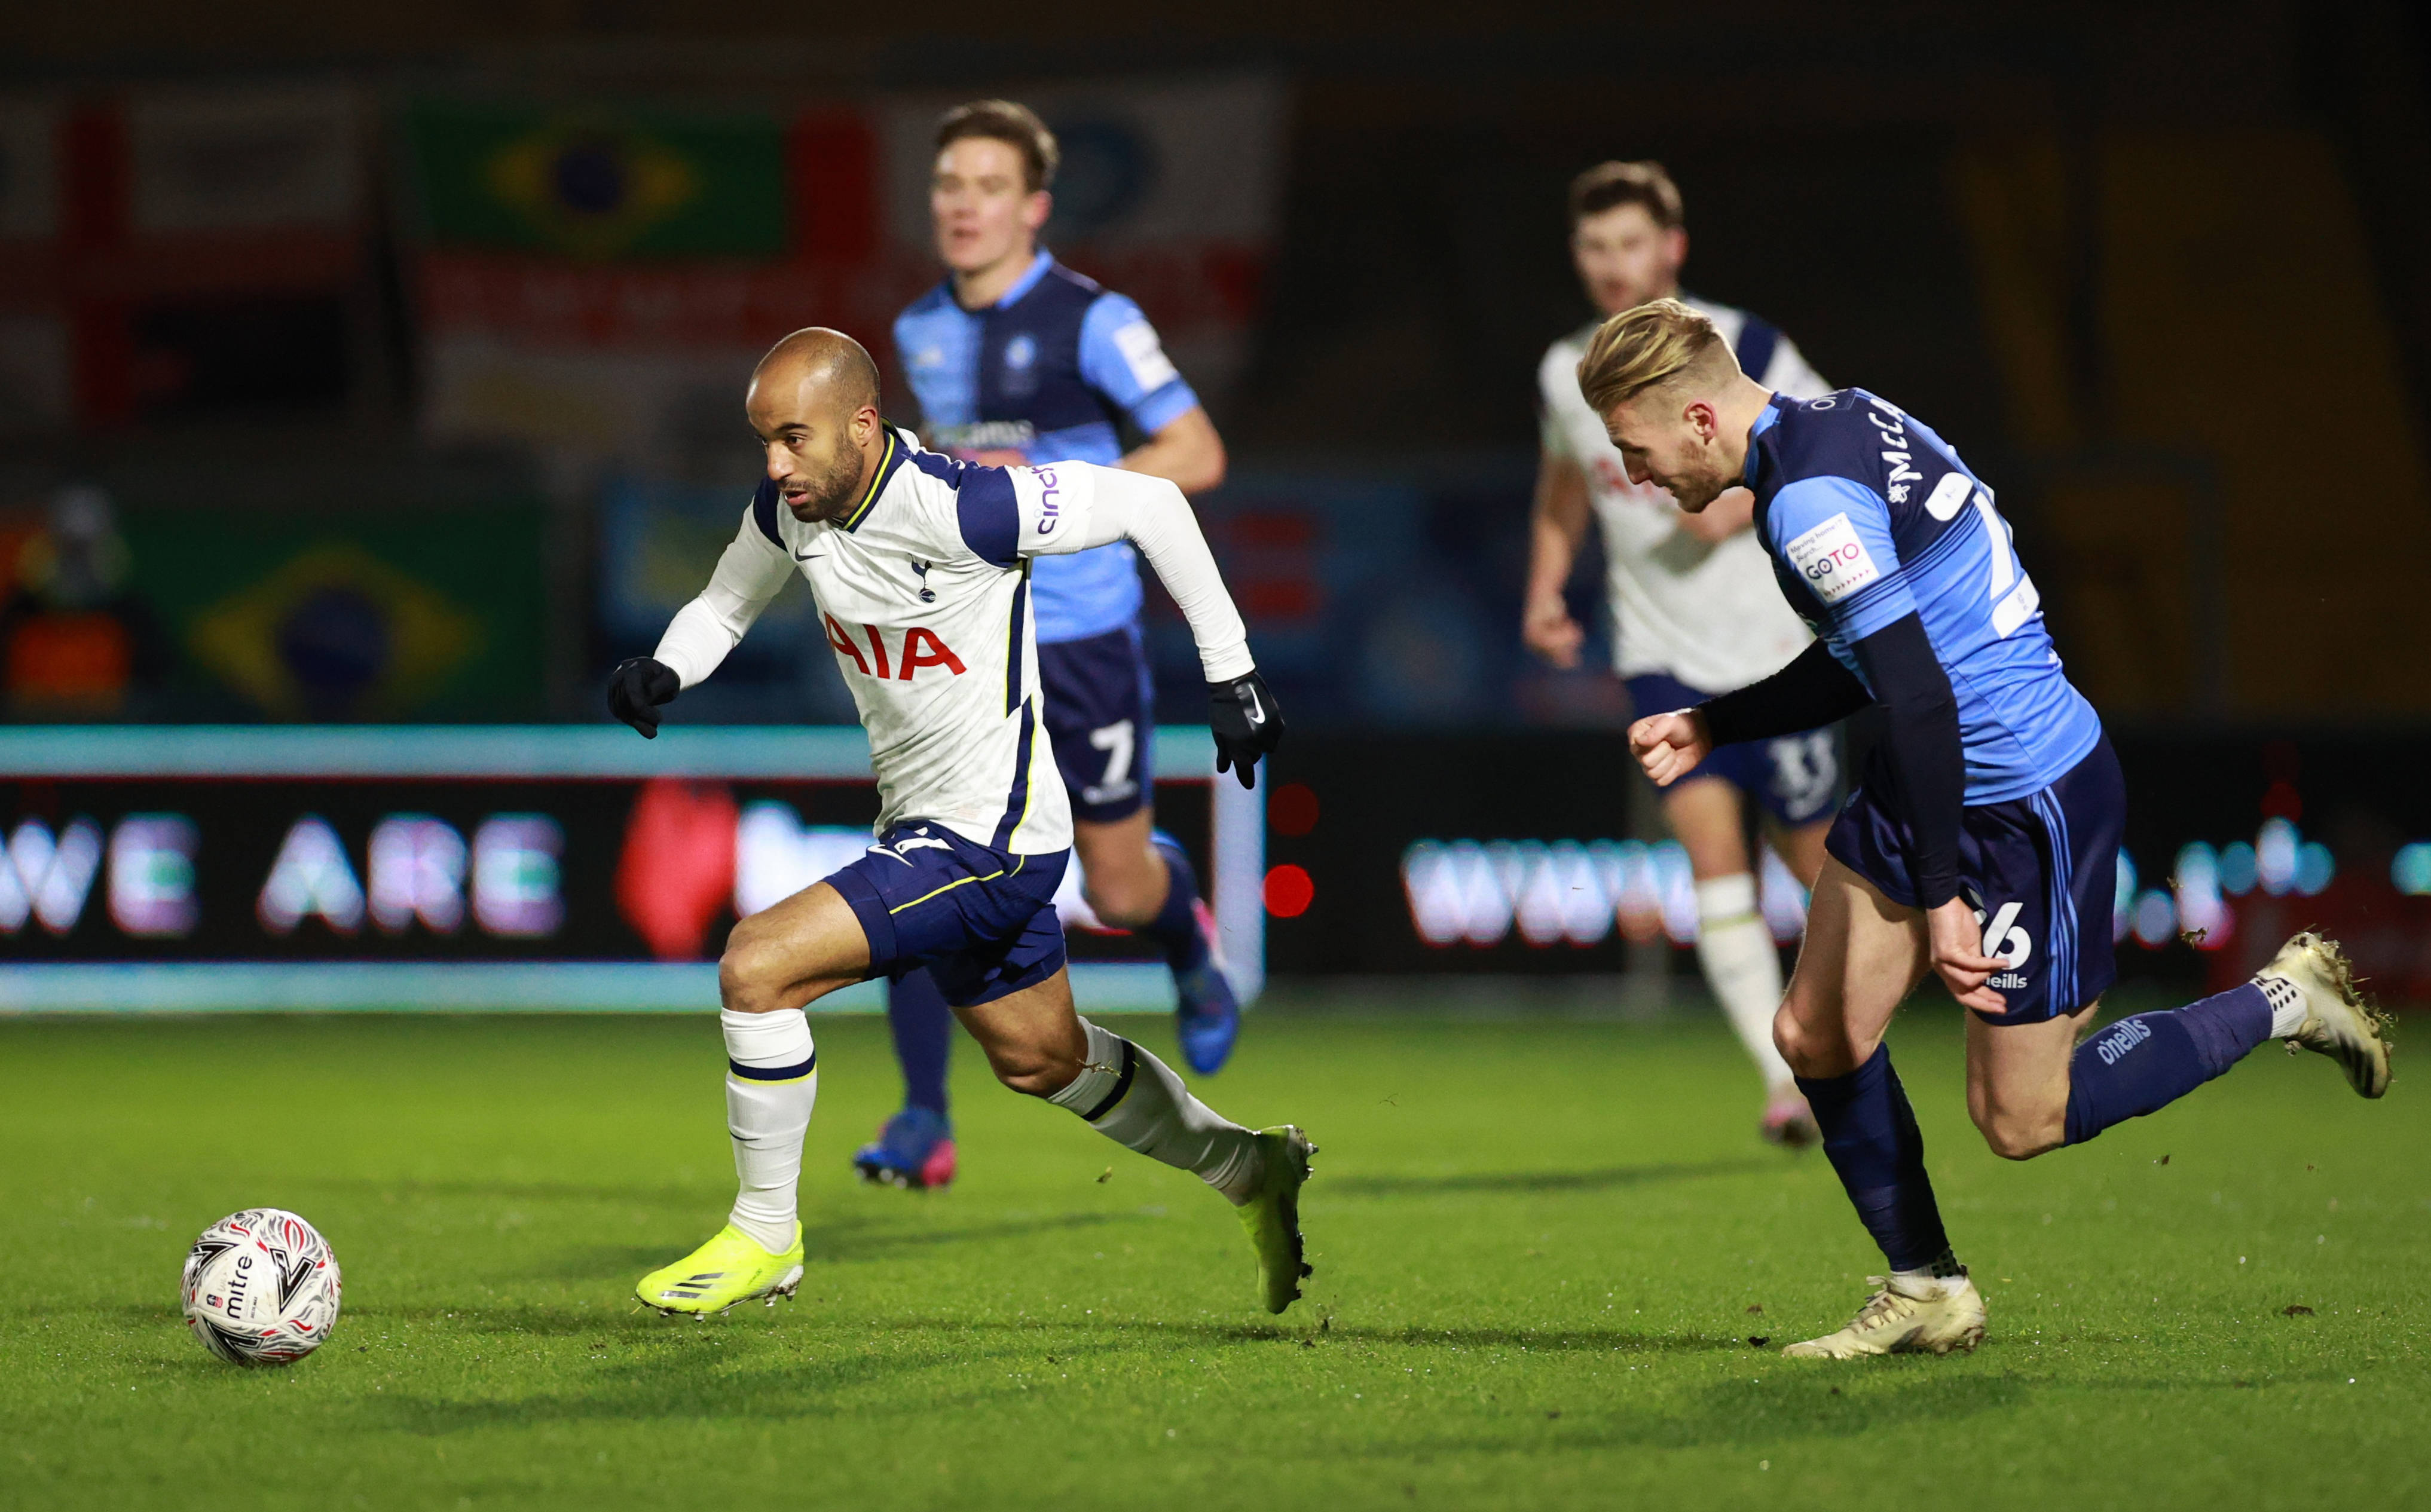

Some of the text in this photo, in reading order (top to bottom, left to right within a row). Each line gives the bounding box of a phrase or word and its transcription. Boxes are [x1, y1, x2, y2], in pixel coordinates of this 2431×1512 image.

[1790, 536, 1815, 554] Moving
[1806, 543, 1859, 580] GOTO
[1925, 472, 2040, 639] 2
[824, 611, 967, 681] AIA
[1088, 718, 1135, 785] 7
[0, 812, 566, 937] WE ARE
[1968, 887, 2032, 971] 6
[227, 1256, 252, 1319] mitre
